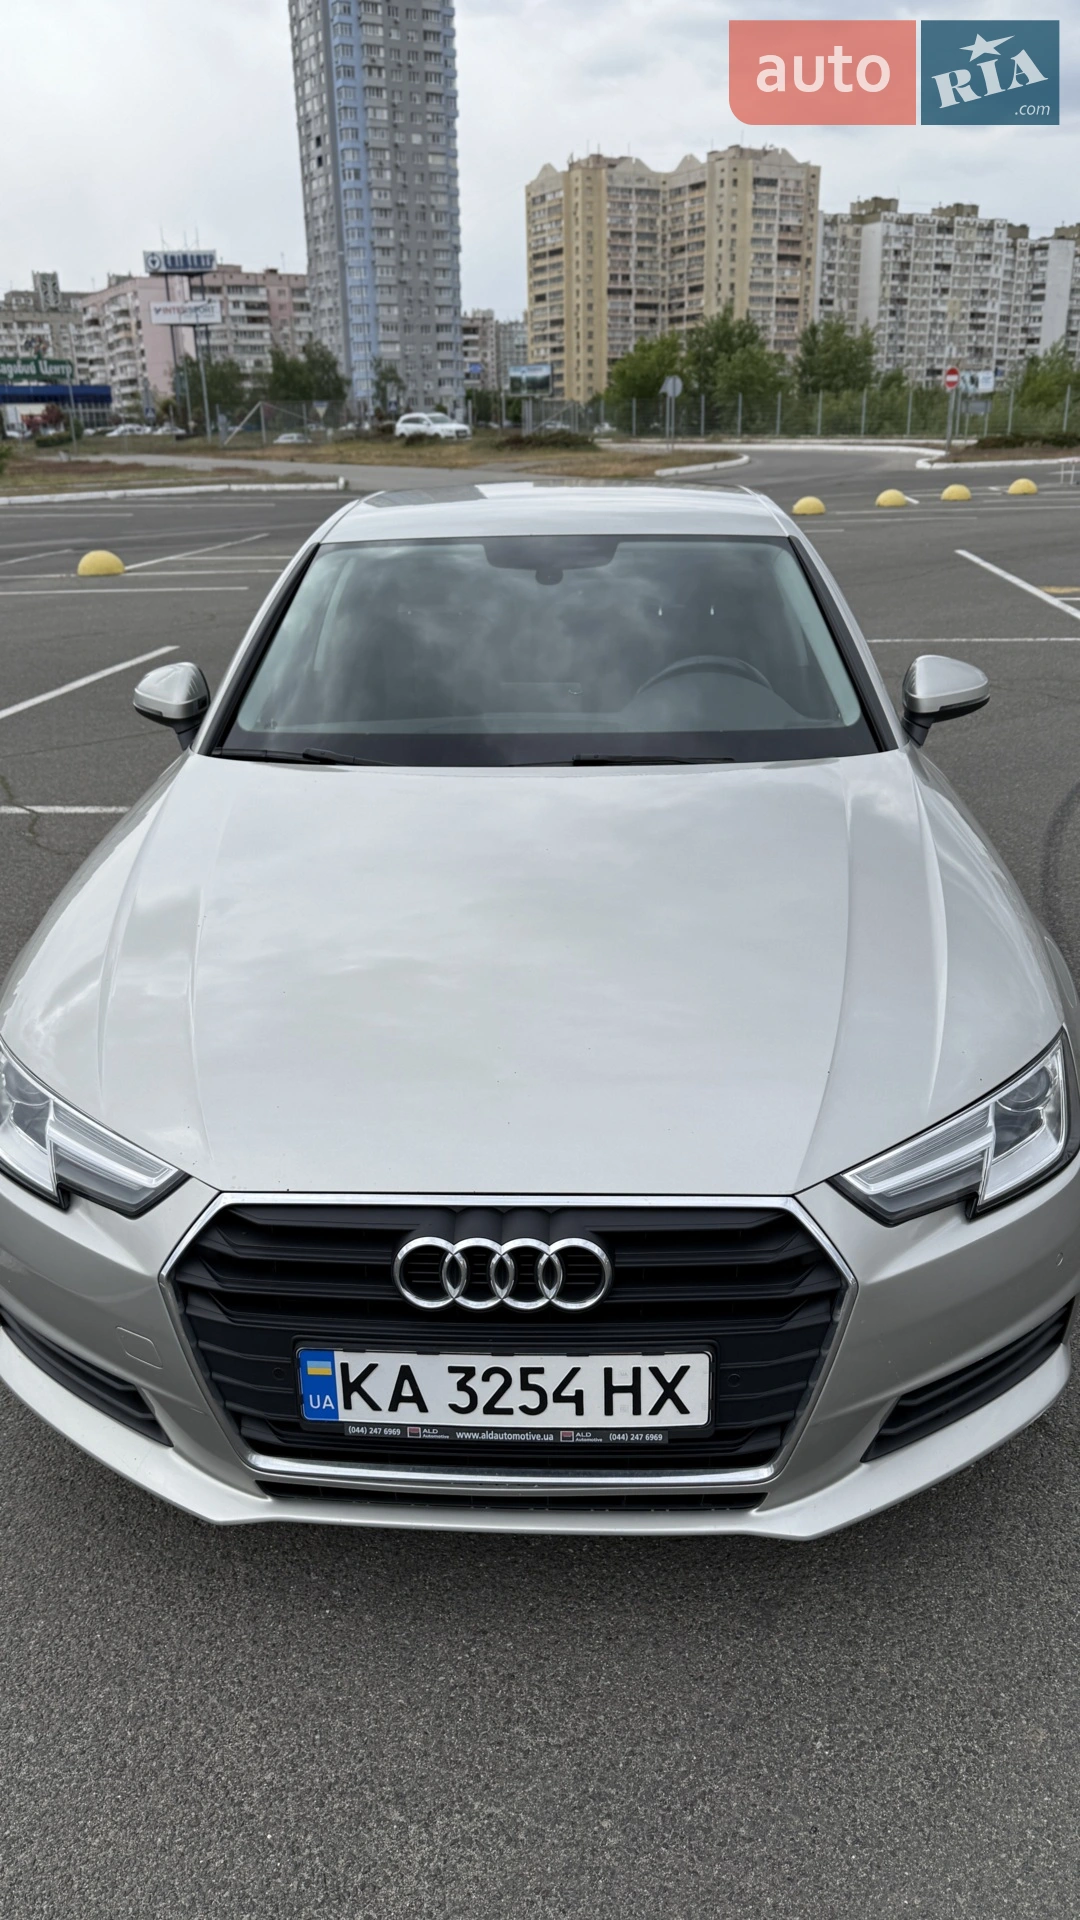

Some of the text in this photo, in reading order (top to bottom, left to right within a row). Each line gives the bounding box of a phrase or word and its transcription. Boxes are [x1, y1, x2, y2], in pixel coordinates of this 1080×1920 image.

[340, 1362, 691, 1416] KA 3254 HX
[309, 1394, 335, 1410] UA
[348, 1425, 401, 1436] (044) 247 6969
[456, 1430, 554, 1441] www.aldautomotive.ua
[609, 1432, 663, 1442] (044) 247 6969
